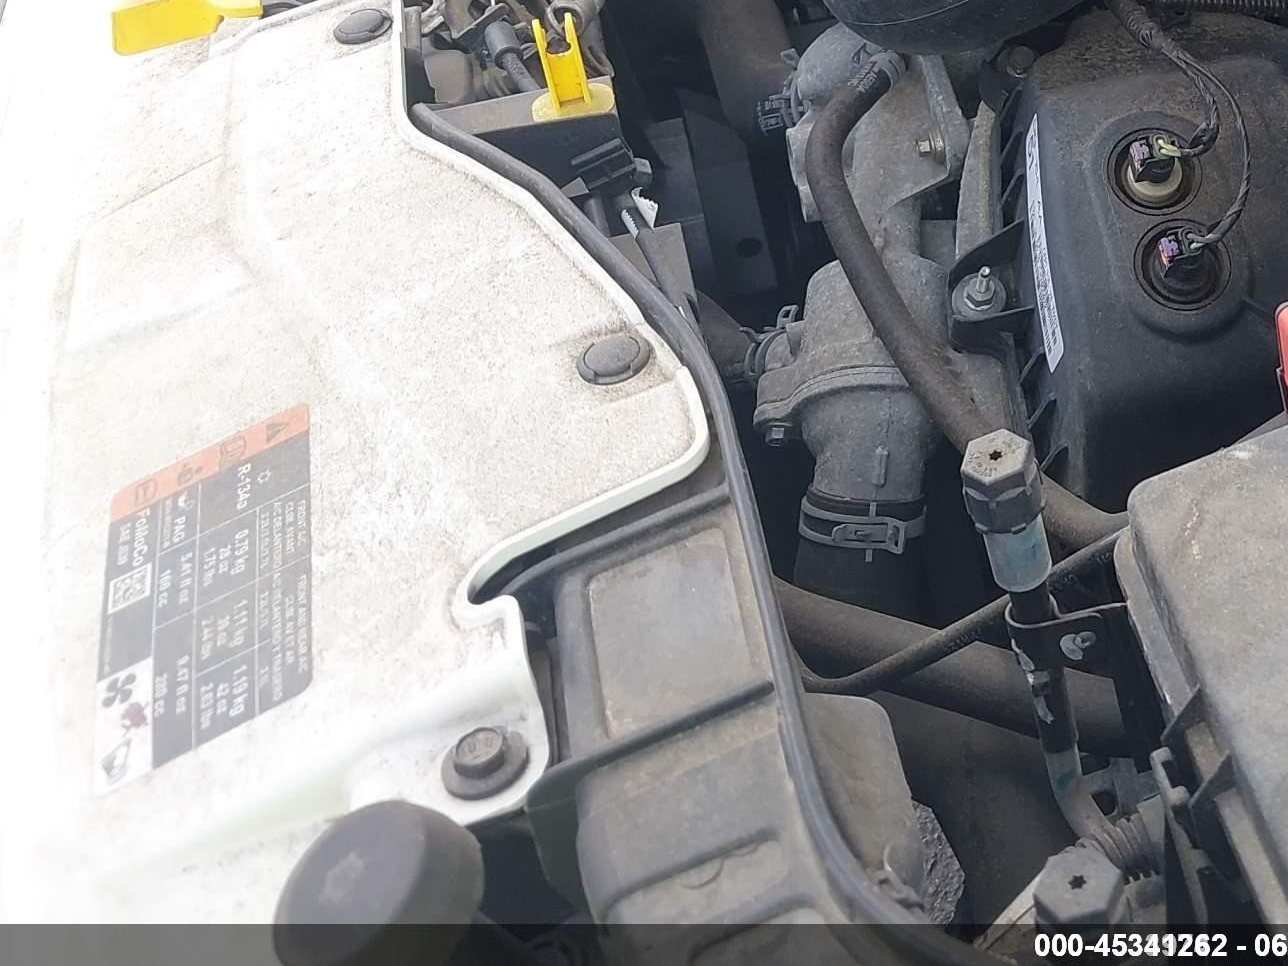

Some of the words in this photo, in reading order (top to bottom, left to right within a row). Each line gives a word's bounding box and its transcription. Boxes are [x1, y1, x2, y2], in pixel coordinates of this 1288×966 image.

[235, 461, 250, 511] R-134a
[132, 506, 149, 567] FoMoCo
[172, 514, 185, 544] PAG
[234, 527, 248, 557] 0.79
[179, 550, 192, 578] 5.41
[202, 545, 215, 570] 1.75
[218, 558, 228, 574] oz
[230, 554, 248, 576] kg
[201, 566, 215, 588] lbs
[158, 590, 168, 608] cc
[178, 587, 188, 606] oz
[233, 597, 248, 628] 1.11
[200, 614, 213, 643] 2.44
[216, 630, 227, 647] oz
[228, 624, 247, 649] kg
[200, 639, 213, 661] lbs
[216, 679, 228, 699] 42
[232, 661, 247, 695] 1.19
[154, 698, 164, 718] cc
[175, 695, 186, 715] oz
[216, 697, 226, 715] oz
[228, 691, 247, 718] kg
[199, 706, 213, 731] lbs
